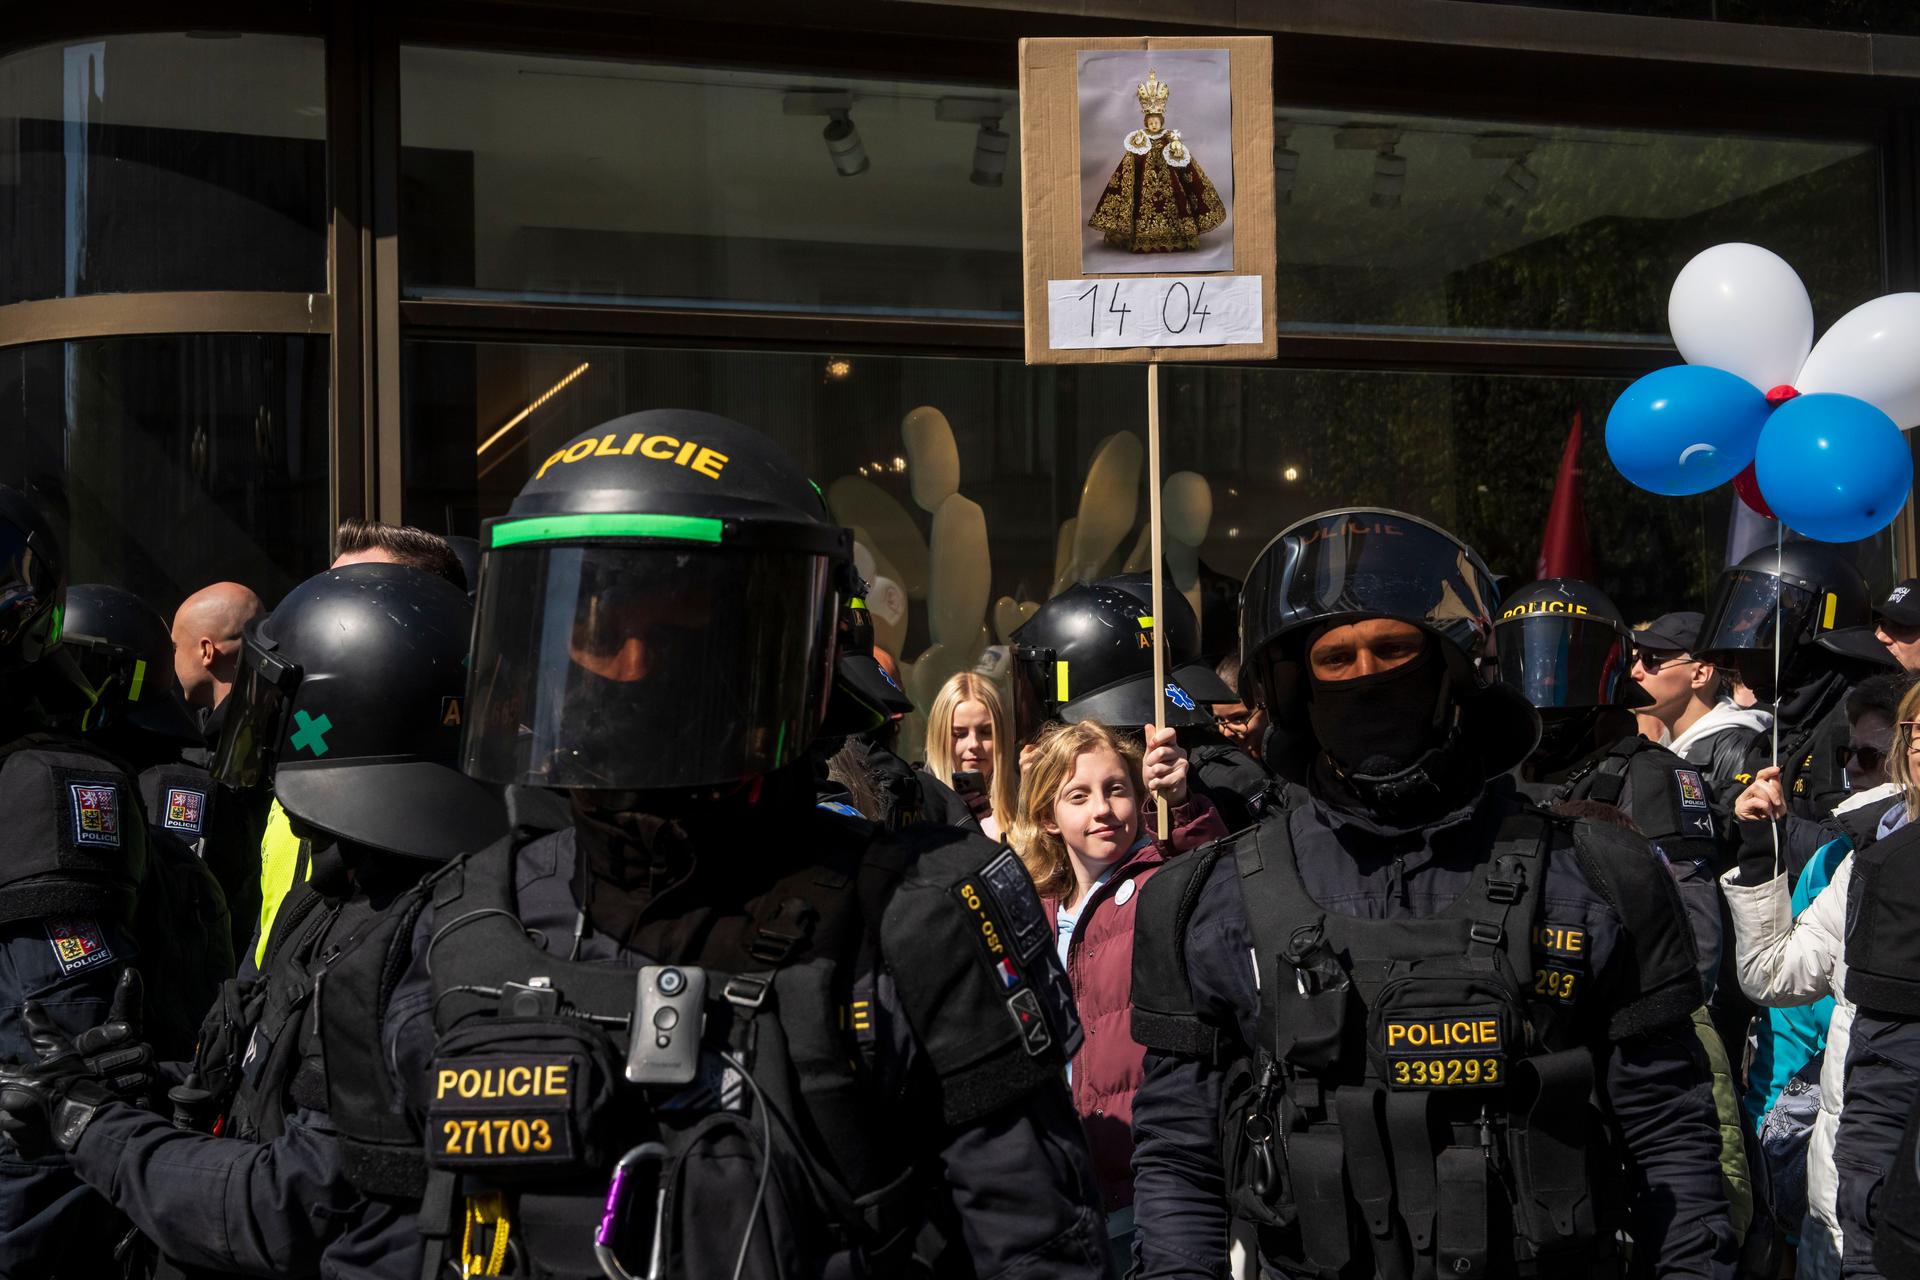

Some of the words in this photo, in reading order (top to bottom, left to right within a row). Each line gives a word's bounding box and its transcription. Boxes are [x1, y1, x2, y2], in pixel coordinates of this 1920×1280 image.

[1078, 281, 1132, 338] 14
[1162, 281, 1212, 334] 04
[534, 432, 730, 481] POLICIE
[81, 832, 119, 843] POLICIE
[167, 820, 198, 829] POLICIE
[65, 949, 108, 971] POLICIE
[1388, 1020, 1498, 1047] POLICIE
[436, 1065, 569, 1100] POLICIE
[1394, 1057, 1499, 1086] 339293
[443, 1118, 553, 1155] 271703
